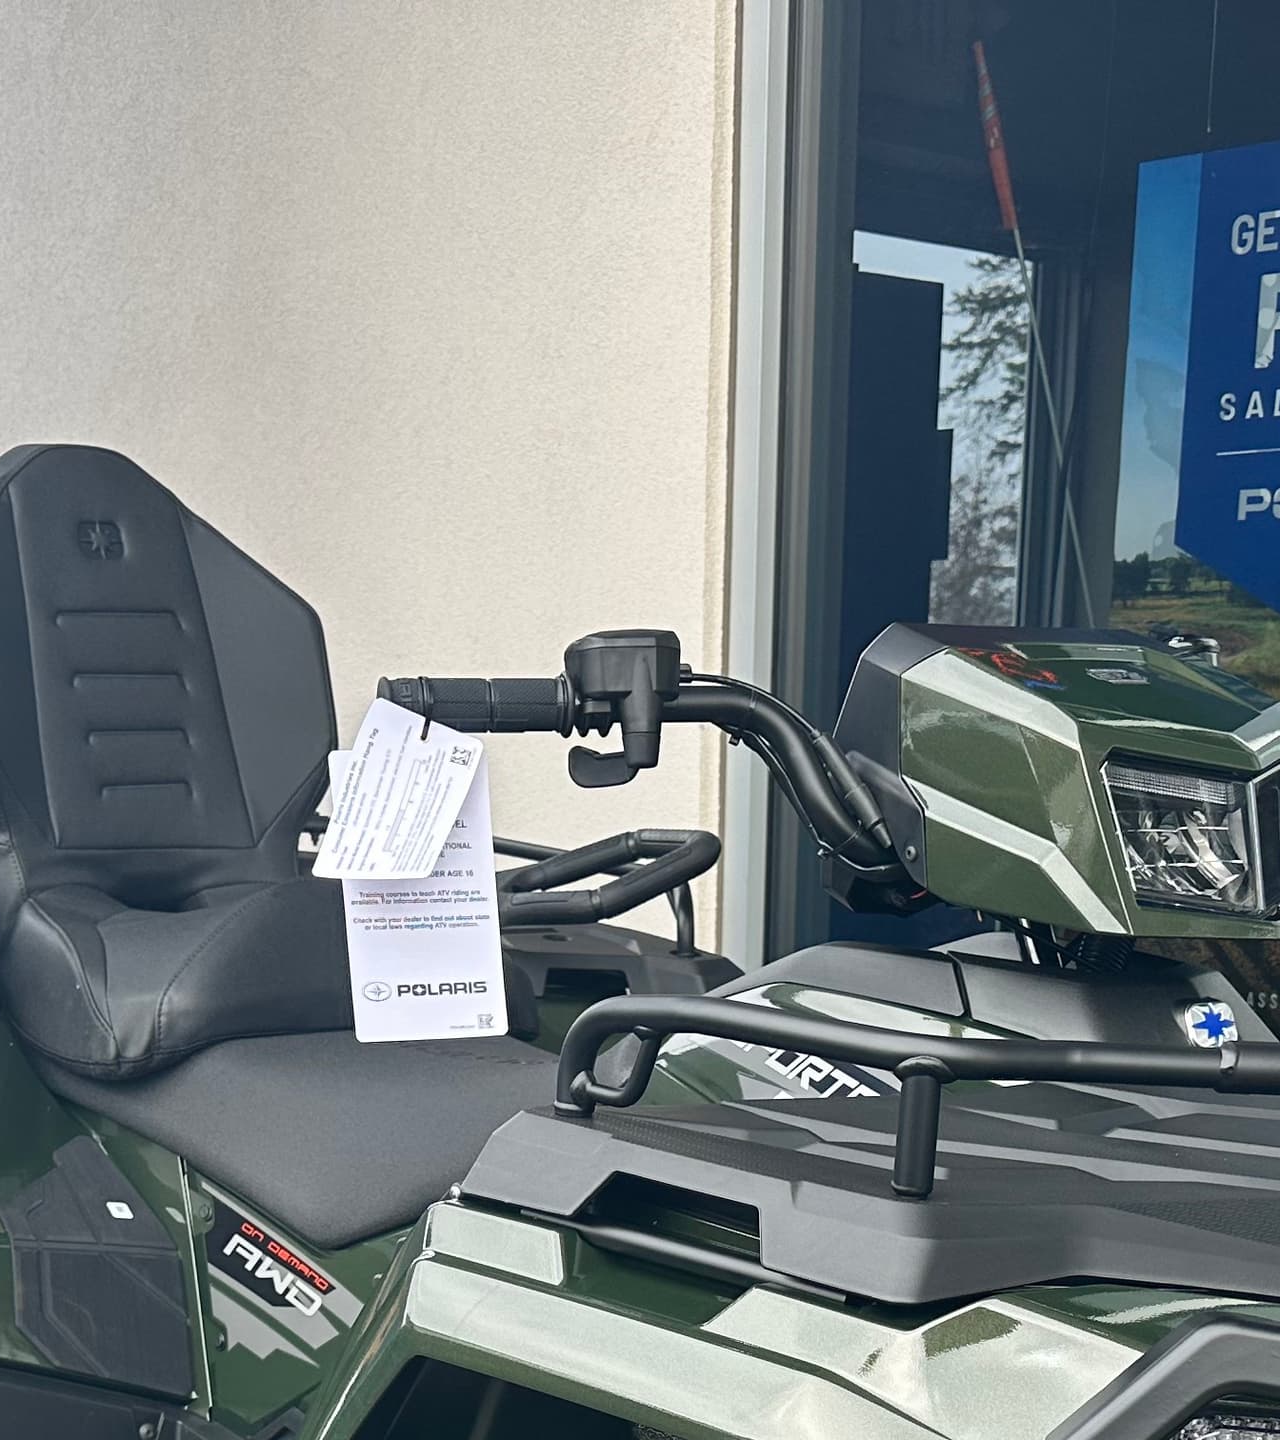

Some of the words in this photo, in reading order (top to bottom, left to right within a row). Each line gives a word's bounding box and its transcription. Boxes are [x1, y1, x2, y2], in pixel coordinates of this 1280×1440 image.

[442, 842, 472, 850] TIONAL
[397, 981, 488, 998] POLARIS
[223, 1234, 322, 1317] AWD
[268, 1241, 329, 1290] DEMAND
